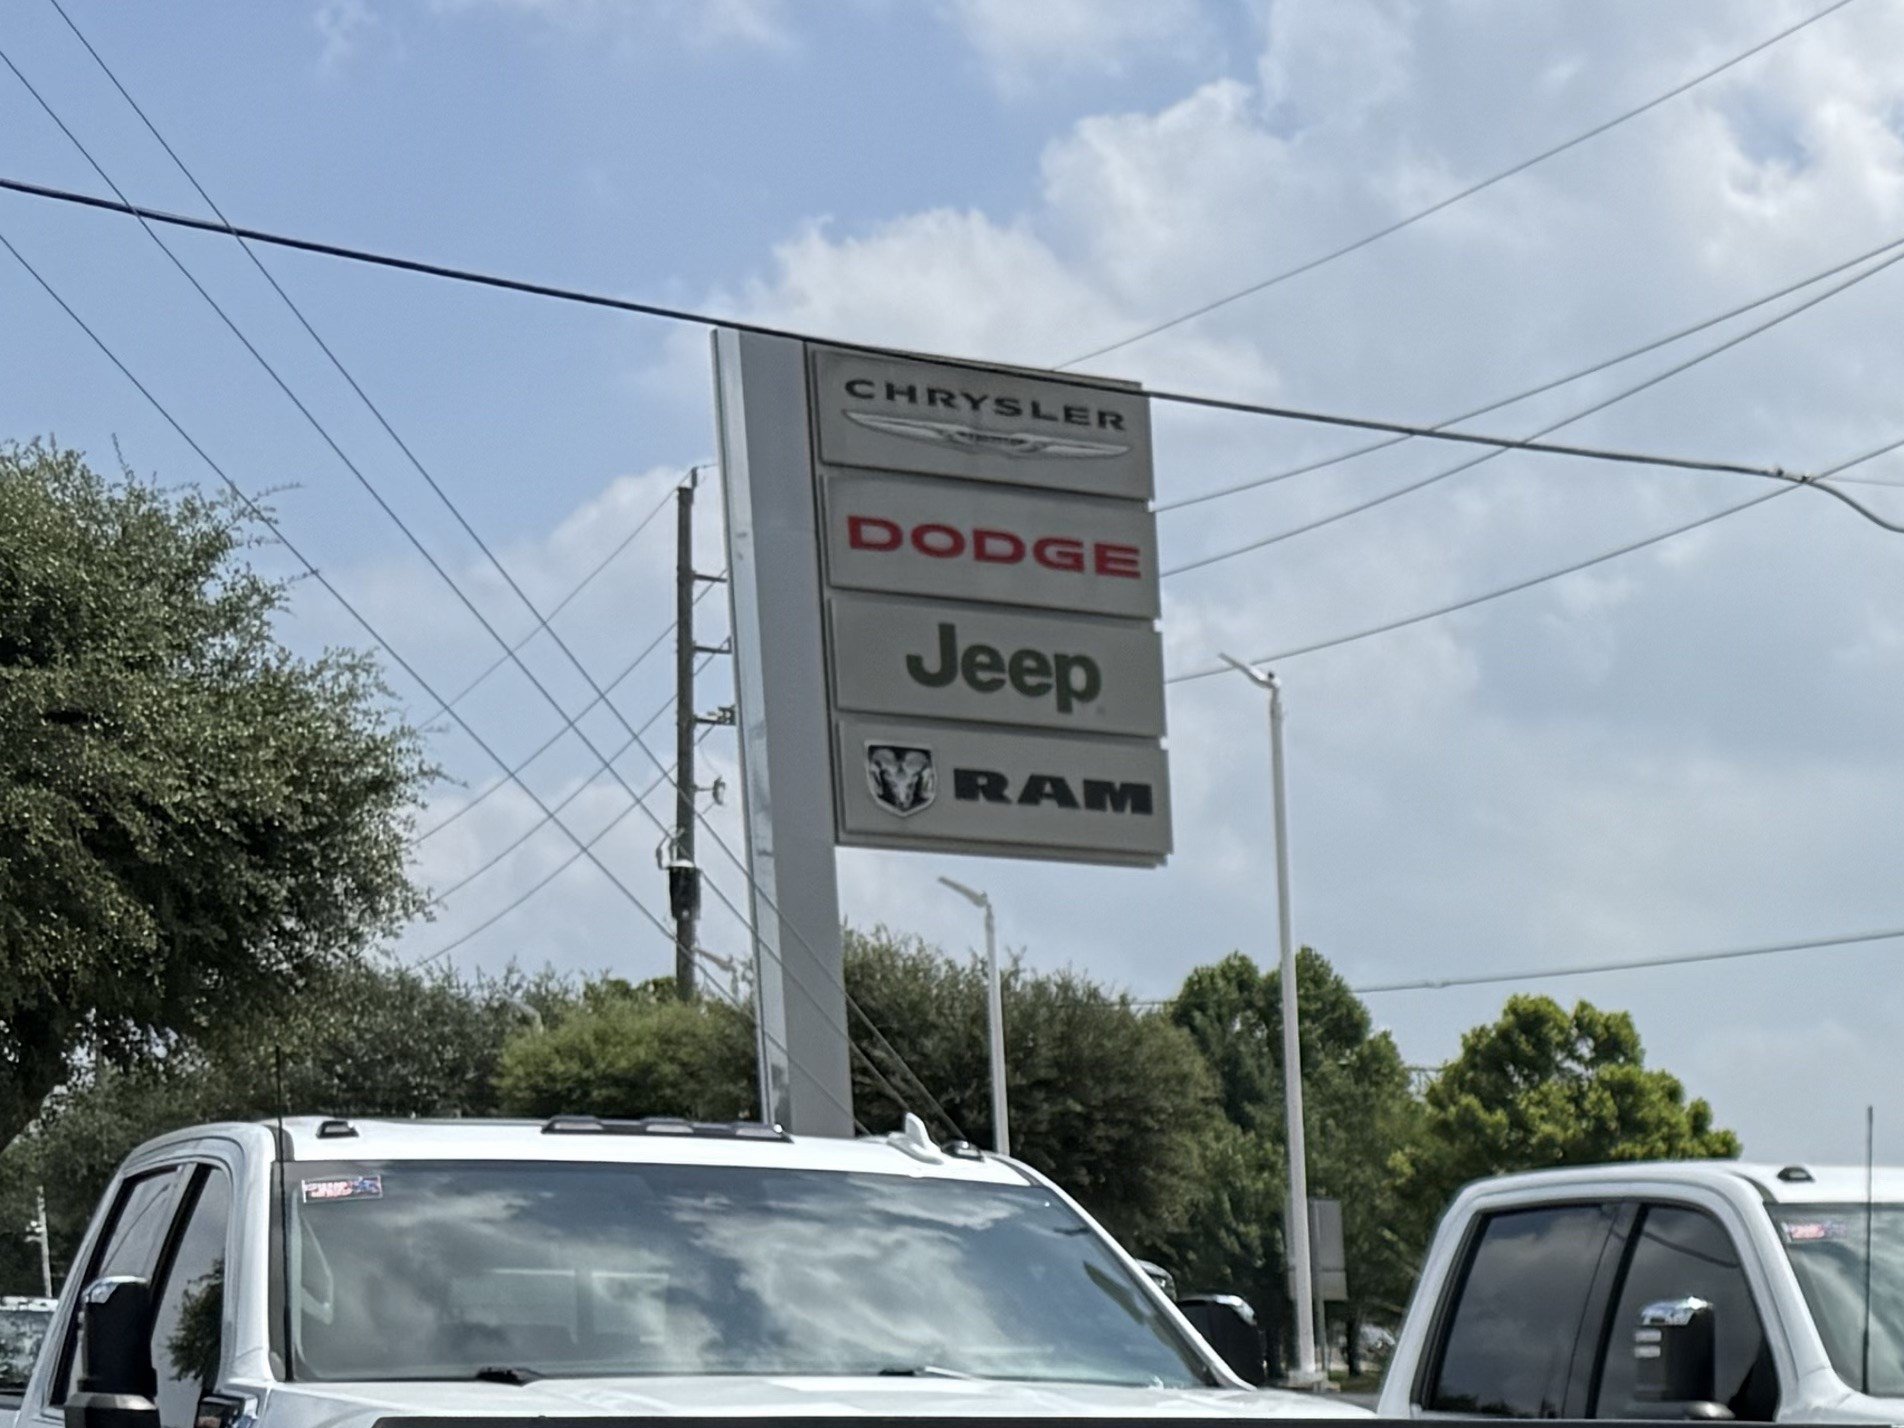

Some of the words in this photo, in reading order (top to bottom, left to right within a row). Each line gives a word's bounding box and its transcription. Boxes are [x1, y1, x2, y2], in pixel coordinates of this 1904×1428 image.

[843, 378, 1127, 431] CHRYSLER
[847, 514, 1143, 579] DODGE
[906, 622, 1102, 714] Jeep
[953, 767, 1154, 816] RAM
